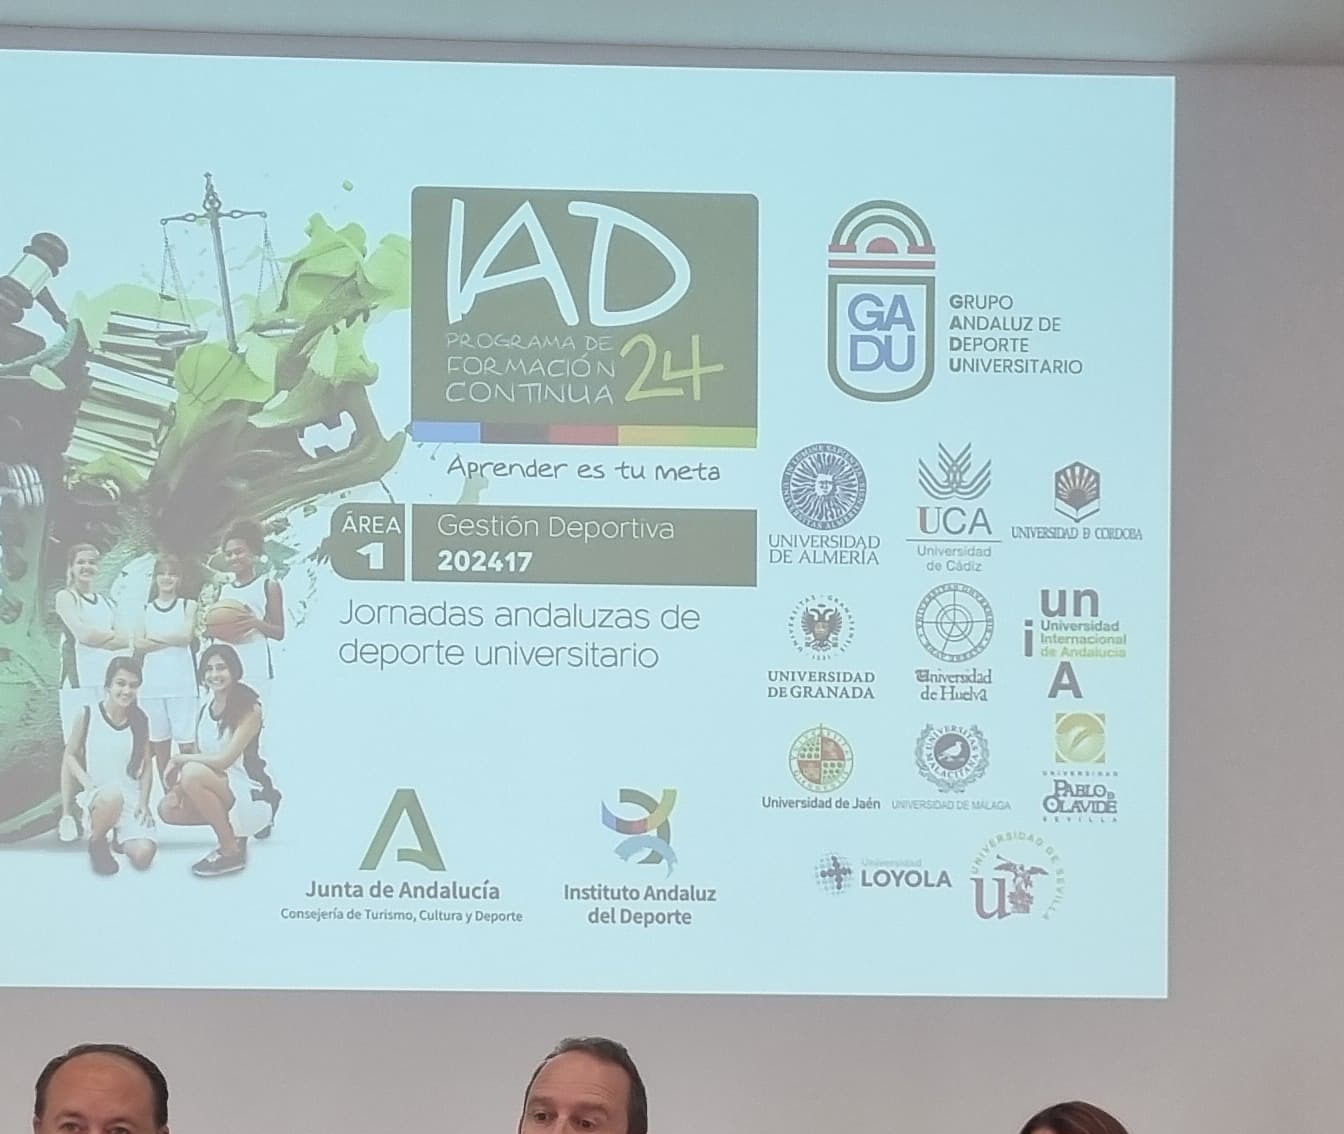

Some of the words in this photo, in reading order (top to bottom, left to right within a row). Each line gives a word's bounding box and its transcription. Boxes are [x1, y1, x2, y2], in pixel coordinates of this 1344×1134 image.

[447, 198, 691, 327] IAD
[949, 294, 1013, 311] GRUPO
[949, 315, 1033, 332] ANDALUZ
[1039, 316, 1061, 332] DE
[446, 332, 576, 351] PROGRAMA
[585, 334, 615, 352] DE
[949, 336, 1030, 353] DEPORTE
[446, 353, 616, 378] FORMACIÓN
[619, 333, 724, 402] 24
[949, 358, 1084, 375] UNIVERSITARIO
[444, 381, 615, 405] CONTINUA
[446, 455, 568, 479] Aprender
[577, 463, 606, 480] es
[614, 461, 645, 481] tu
[655, 463, 721, 482] meta
[341, 511, 402, 535] ÁREA
[437, 513, 539, 538] Gestión
[549, 516, 675, 543] Deportiva
[917, 506, 993, 536] UCA
[768, 534, 881, 549] UNIVERSIDAD
[356, 542, 384, 570] 1
[769, 549, 793, 564] DE
[798, 549, 880, 566] ALMERÍA
[917, 545, 993, 558] Universidad
[437, 550, 533, 573] 202417
[926, 560, 943, 572] de
[946, 558, 983, 573] Cádiz
[1040, 587, 1100, 619] un
[339, 599, 484, 628] Jornadas
[494, 603, 650, 631] andaluzas
[660, 605, 701, 631] de
[1040, 619, 1120, 633] Universidad
[1040, 634, 1127, 646] Internacional
[339, 638, 464, 670] deporte
[474, 642, 660, 669] universitario
[1040, 647, 1056, 658] de
[768, 671, 875, 683] UNIVERSIDAD
[1047, 661, 1084, 699] A
[768, 686, 787, 698] DE
[790, 685, 875, 699] GRANADA
[920, 685, 937, 700] de
[940, 685, 988, 701] Huelva
[1053, 779, 1106, 798] PABLO
[761, 796, 832, 809] Universidad
[835, 797, 850, 809] de
[852, 796, 881, 810] Jaén
[1042, 795, 1118, 813] OLAVIDE
[861, 869, 953, 889] LOYOLA
[304, 880, 363, 899] Junta
[368, 880, 394, 899] de
[399, 879, 500, 900] Andalucía
[564, 883, 640, 901] Instituto
[644, 884, 717, 902] Andaluz
[280, 907, 344, 924] Consejería
[346, 908, 362, 920] de
[364, 909, 417, 923] Turismo,
[419, 909, 463, 922] Cultura
[465, 912, 473, 924] y
[475, 910, 523, 925] Deporte
[588, 908, 616, 924] del
[620, 908, 692, 928] Deporte
